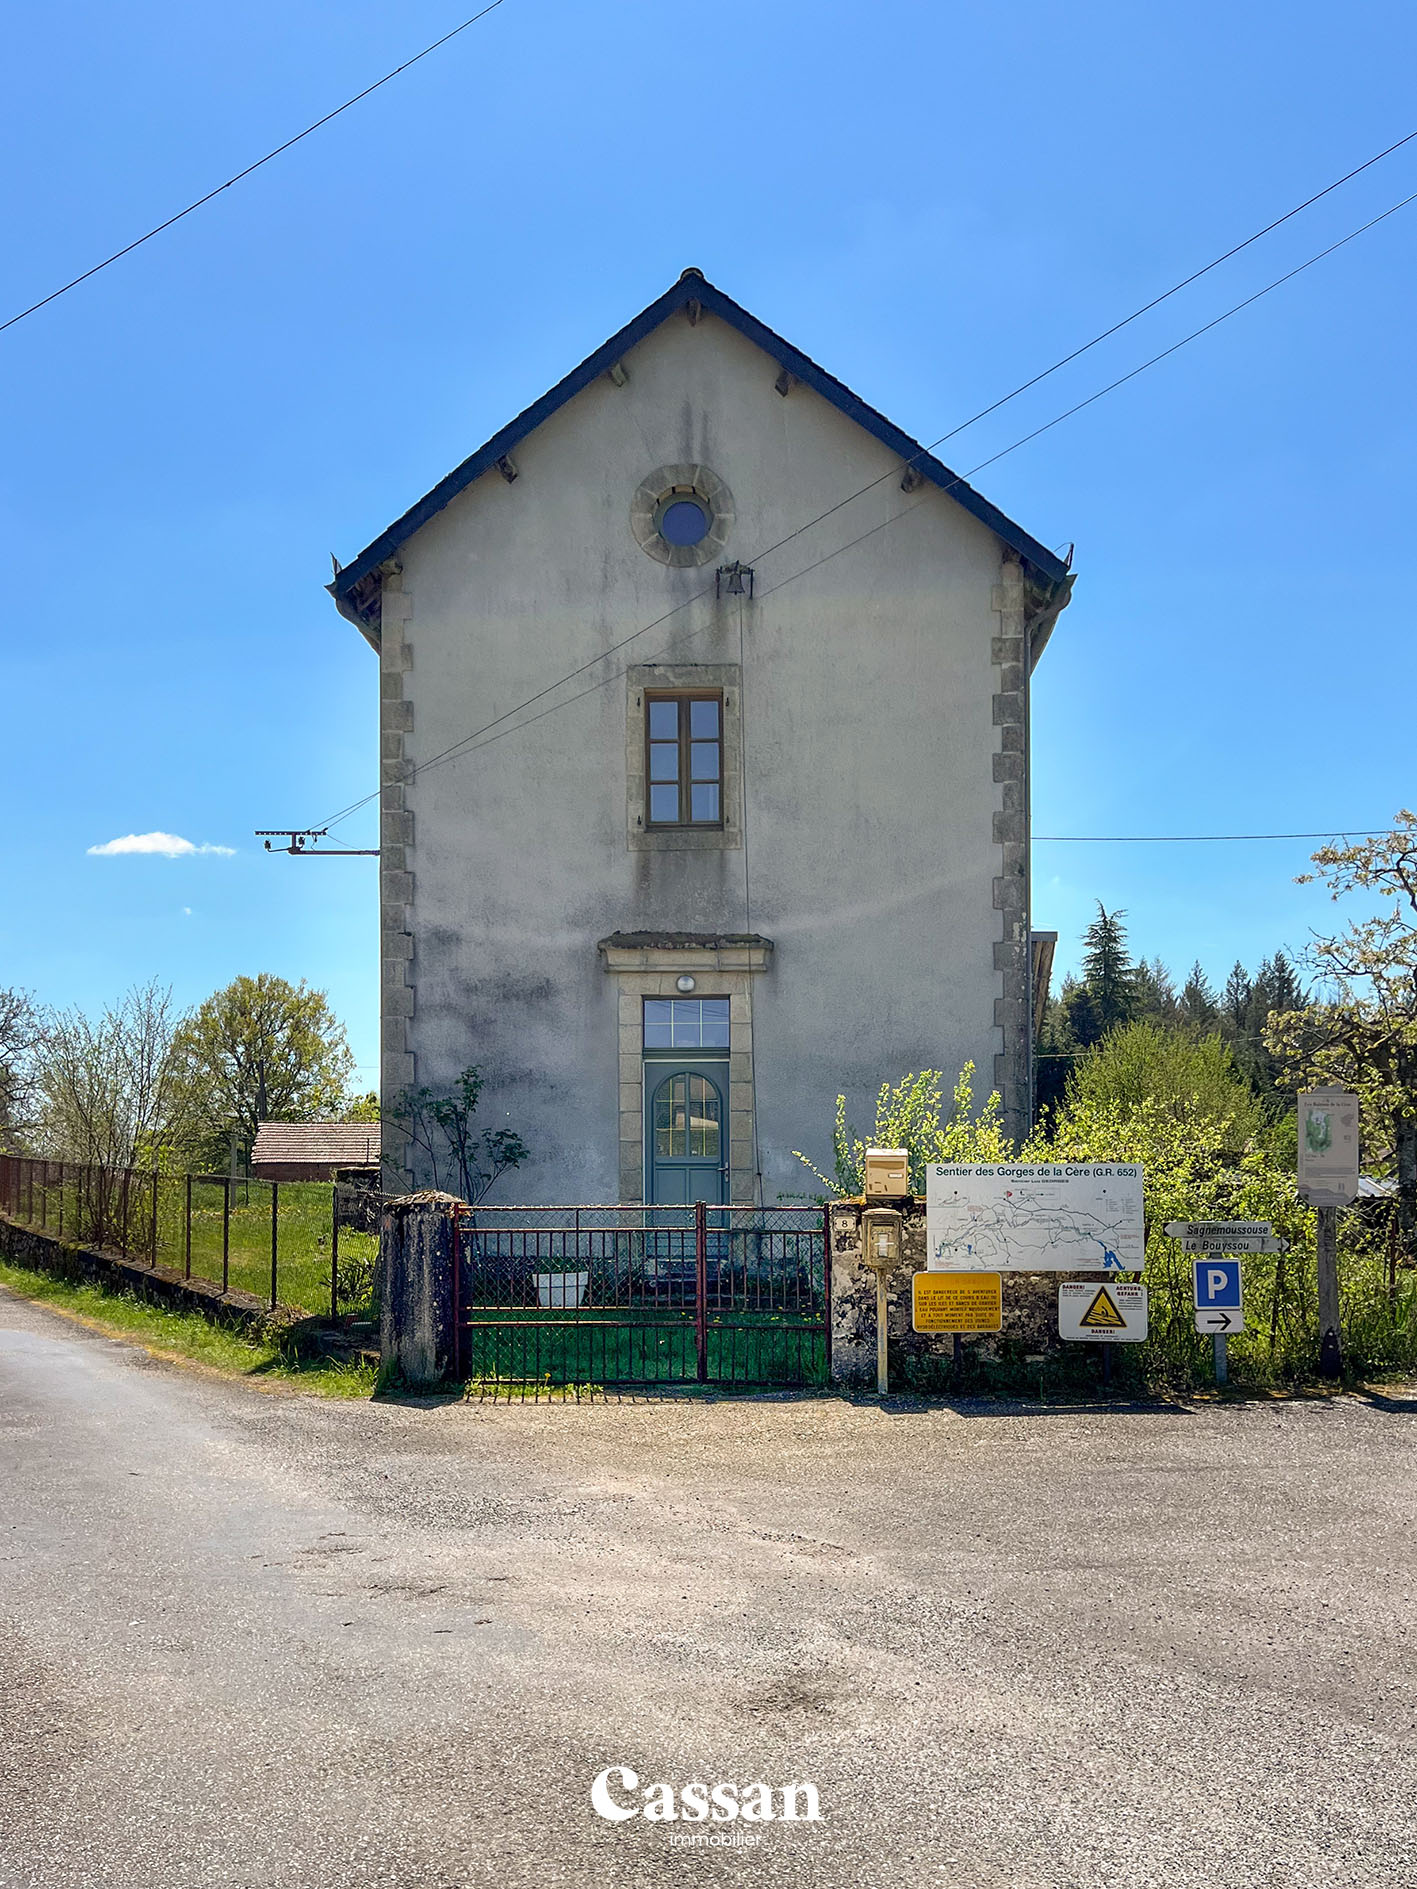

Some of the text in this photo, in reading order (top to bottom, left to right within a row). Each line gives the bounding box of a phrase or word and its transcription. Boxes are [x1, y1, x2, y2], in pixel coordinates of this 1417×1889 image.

[936, 1167, 1137, 1178] Sentier des Gorges de la Cère (G.R. 652)
[842, 1220, 847, 1228] 8
[1187, 1225, 1268, 1237] Sagnemoussouse
[1186, 1241, 1249, 1252] Le Bouyssou
[1207, 1269, 1228, 1300] P
